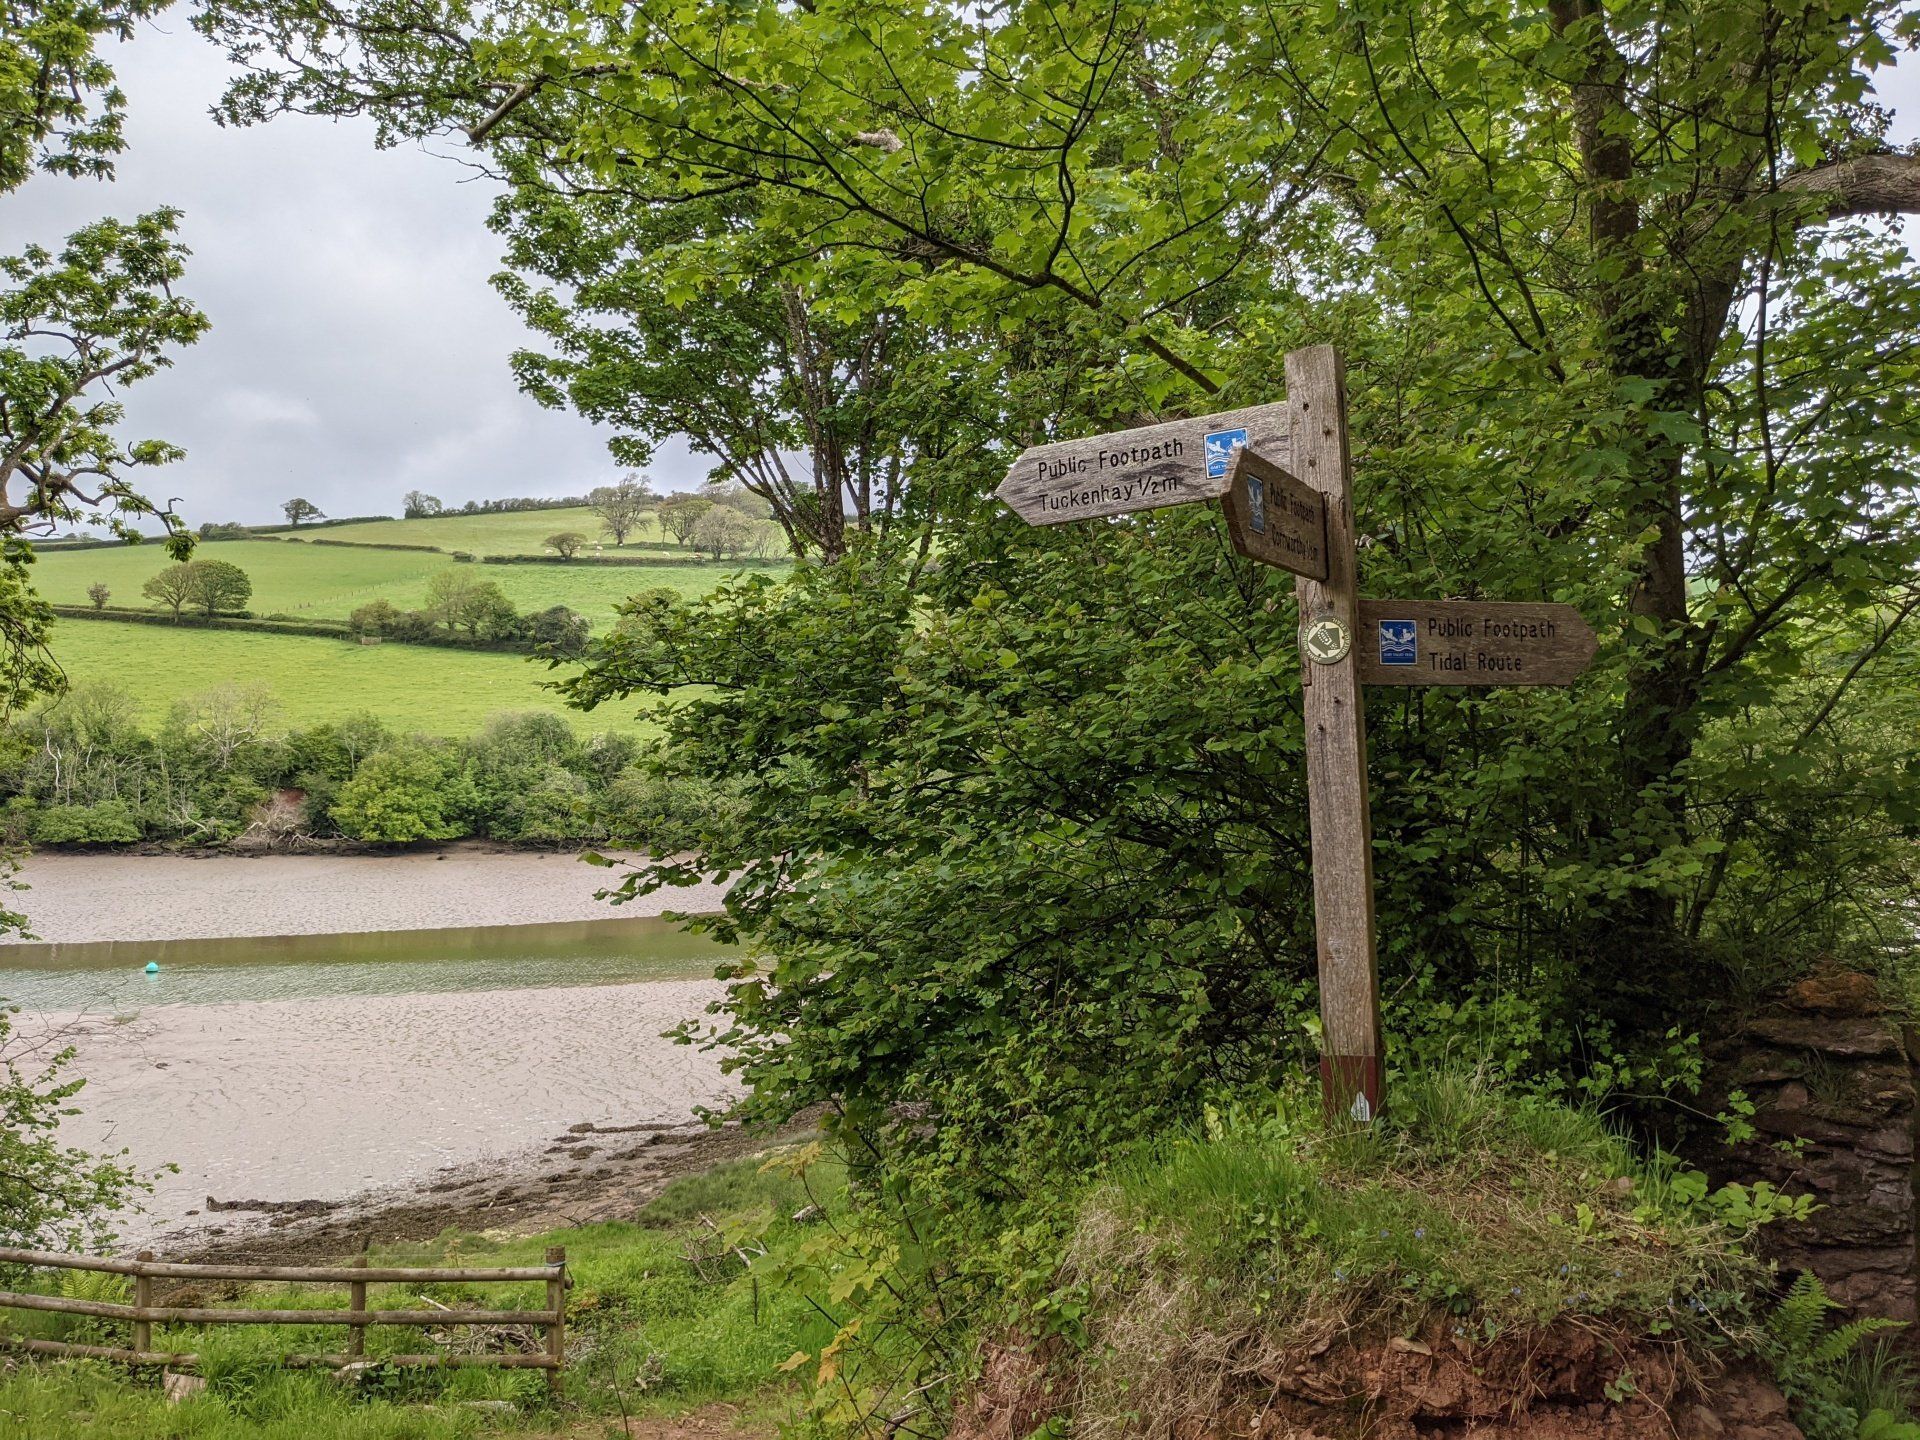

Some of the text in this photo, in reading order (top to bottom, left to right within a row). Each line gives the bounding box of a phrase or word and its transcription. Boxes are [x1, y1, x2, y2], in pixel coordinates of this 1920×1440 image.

[1038, 438, 1184, 480] Public Footpath
[1038, 484, 1134, 511] Tuckenhay
[1332, 618, 1350, 659] HERITAGE TRAIL
[1427, 618, 1555, 642] Public Footpath
[1306, 650, 1322, 662] JOHN
[1429, 652, 1523, 671] Tidal Route
